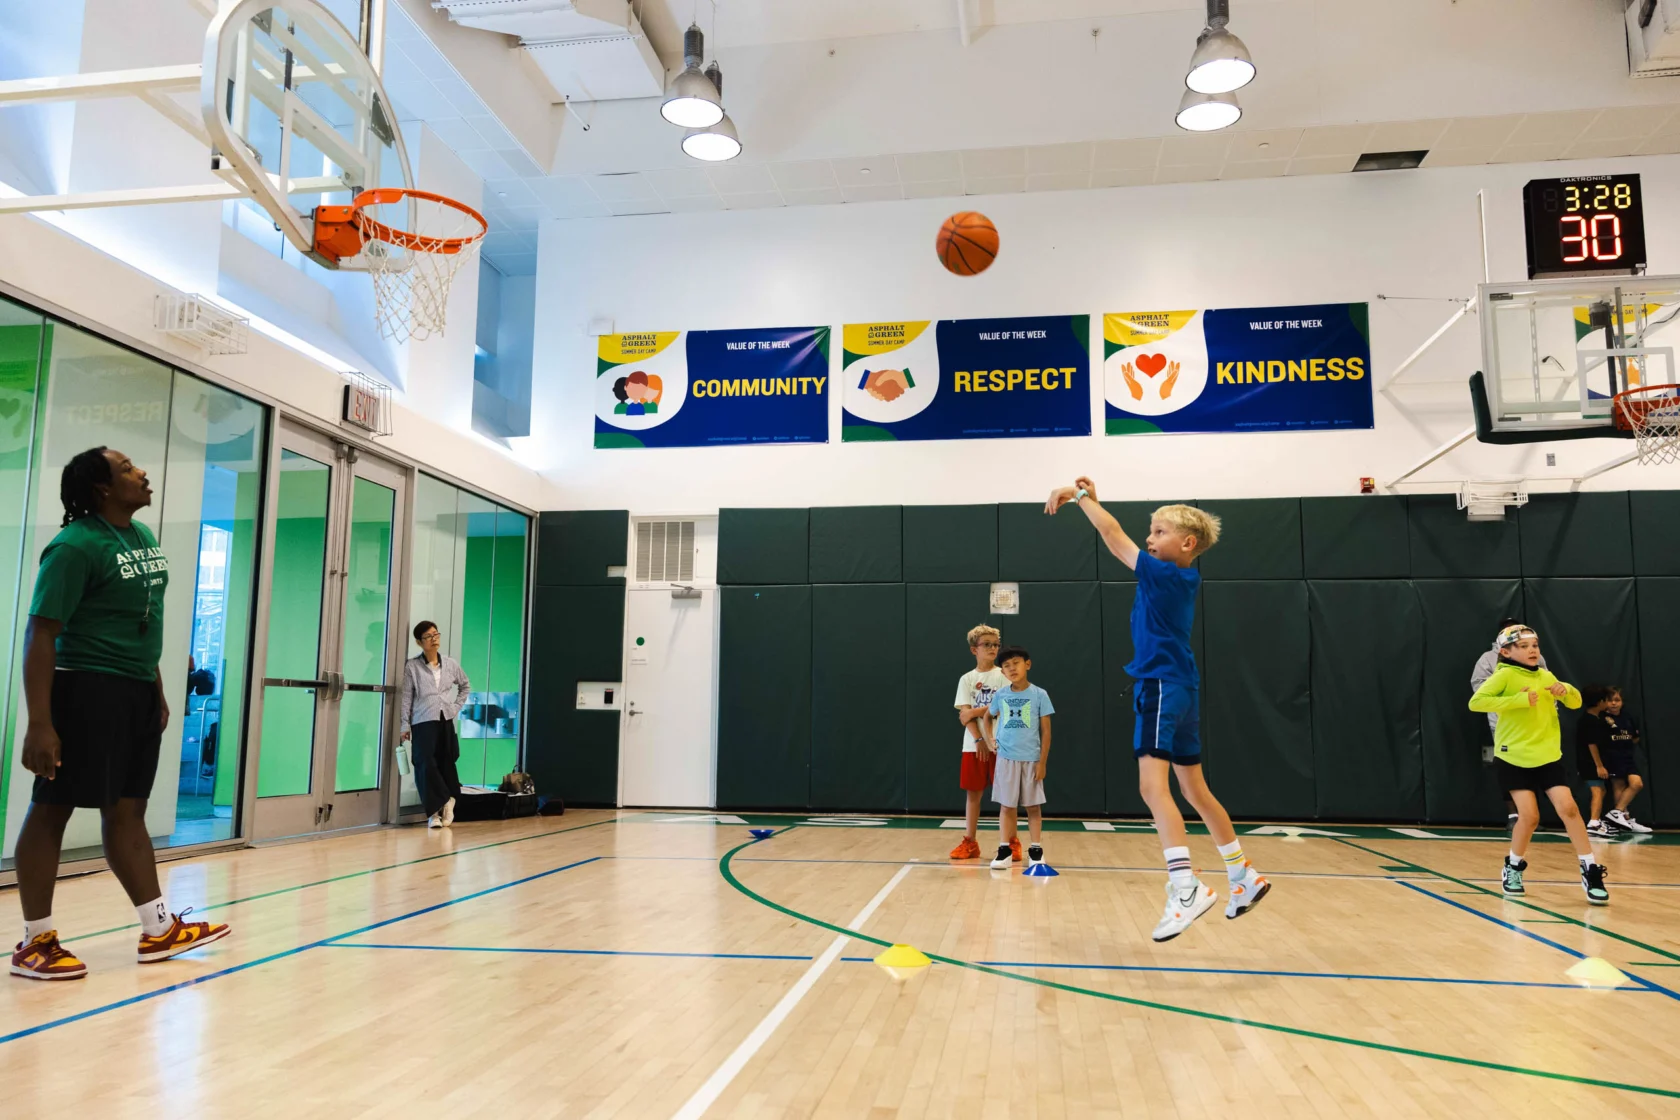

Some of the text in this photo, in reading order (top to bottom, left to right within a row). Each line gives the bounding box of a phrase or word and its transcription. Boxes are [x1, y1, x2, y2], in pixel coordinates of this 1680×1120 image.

[1560, 175, 1612, 183] DAKTRONICS
[1565, 183, 1631, 212] 3:28
[1560, 214, 1622, 262] 30
[979, 330, 1047, 340] VALUE OF THE WEEK
[1250, 319, 1323, 330] VALUE OF THE WEEK
[726, 340, 790, 350] VALUE OF THE WEEK
[954, 367, 1077, 392] RESPECT
[1216, 356, 1365, 384] KINDNESS
[692, 376, 827, 398] COMMUNITY
